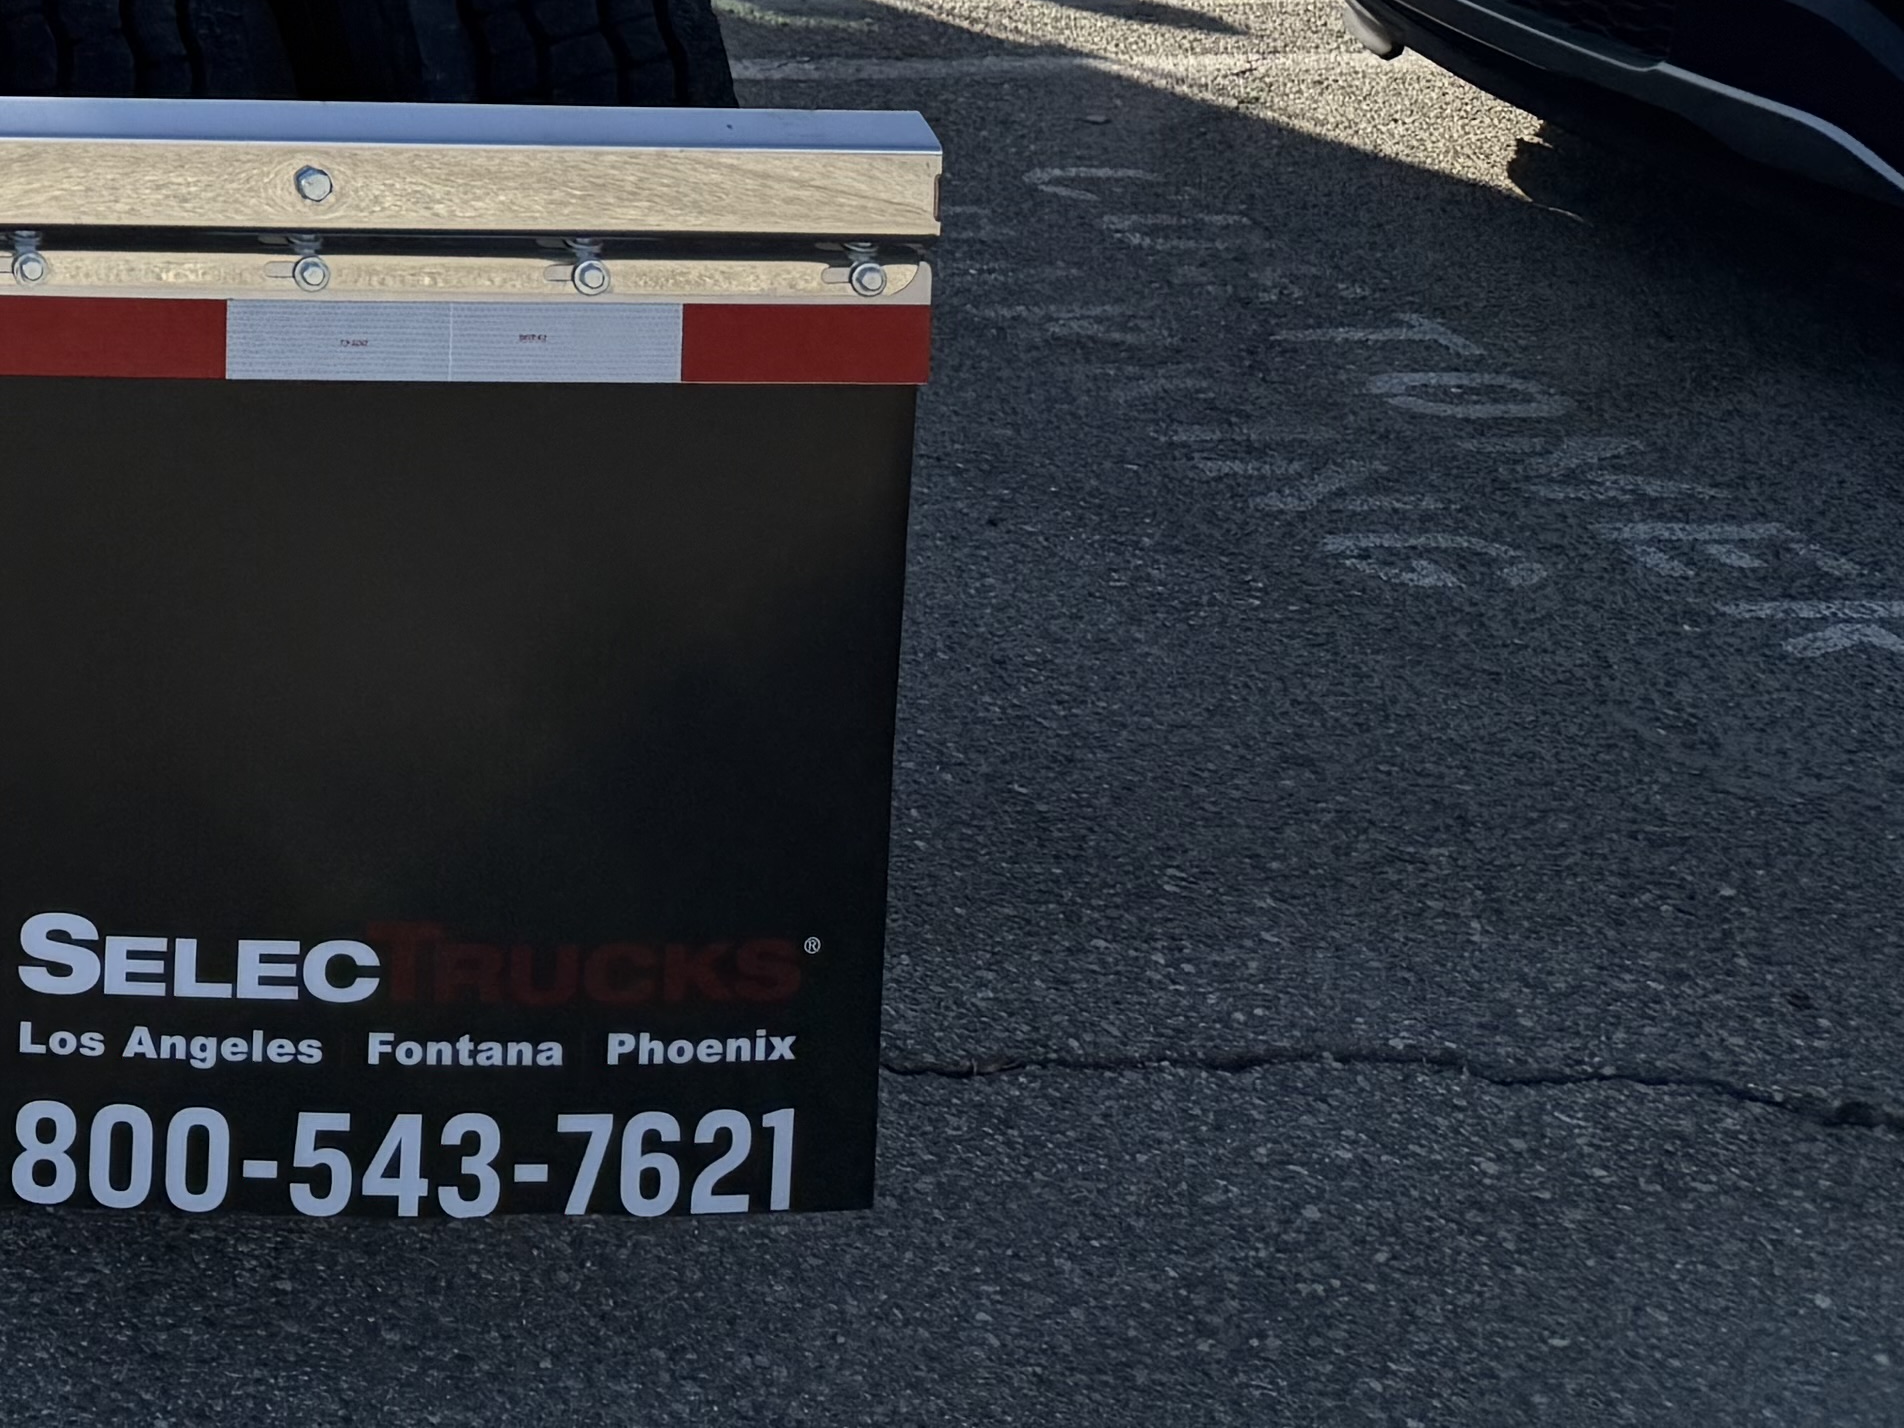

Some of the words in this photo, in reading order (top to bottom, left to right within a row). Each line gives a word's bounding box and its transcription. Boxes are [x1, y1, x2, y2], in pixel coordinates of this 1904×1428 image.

[18, 1021, 106, 1058] Los
[122, 1024, 324, 1070] Angeles
[367, 1032, 564, 1068] Fontana
[607, 1028, 798, 1066] Phoenix
[10, 1100, 796, 1219] 800-543-7621
